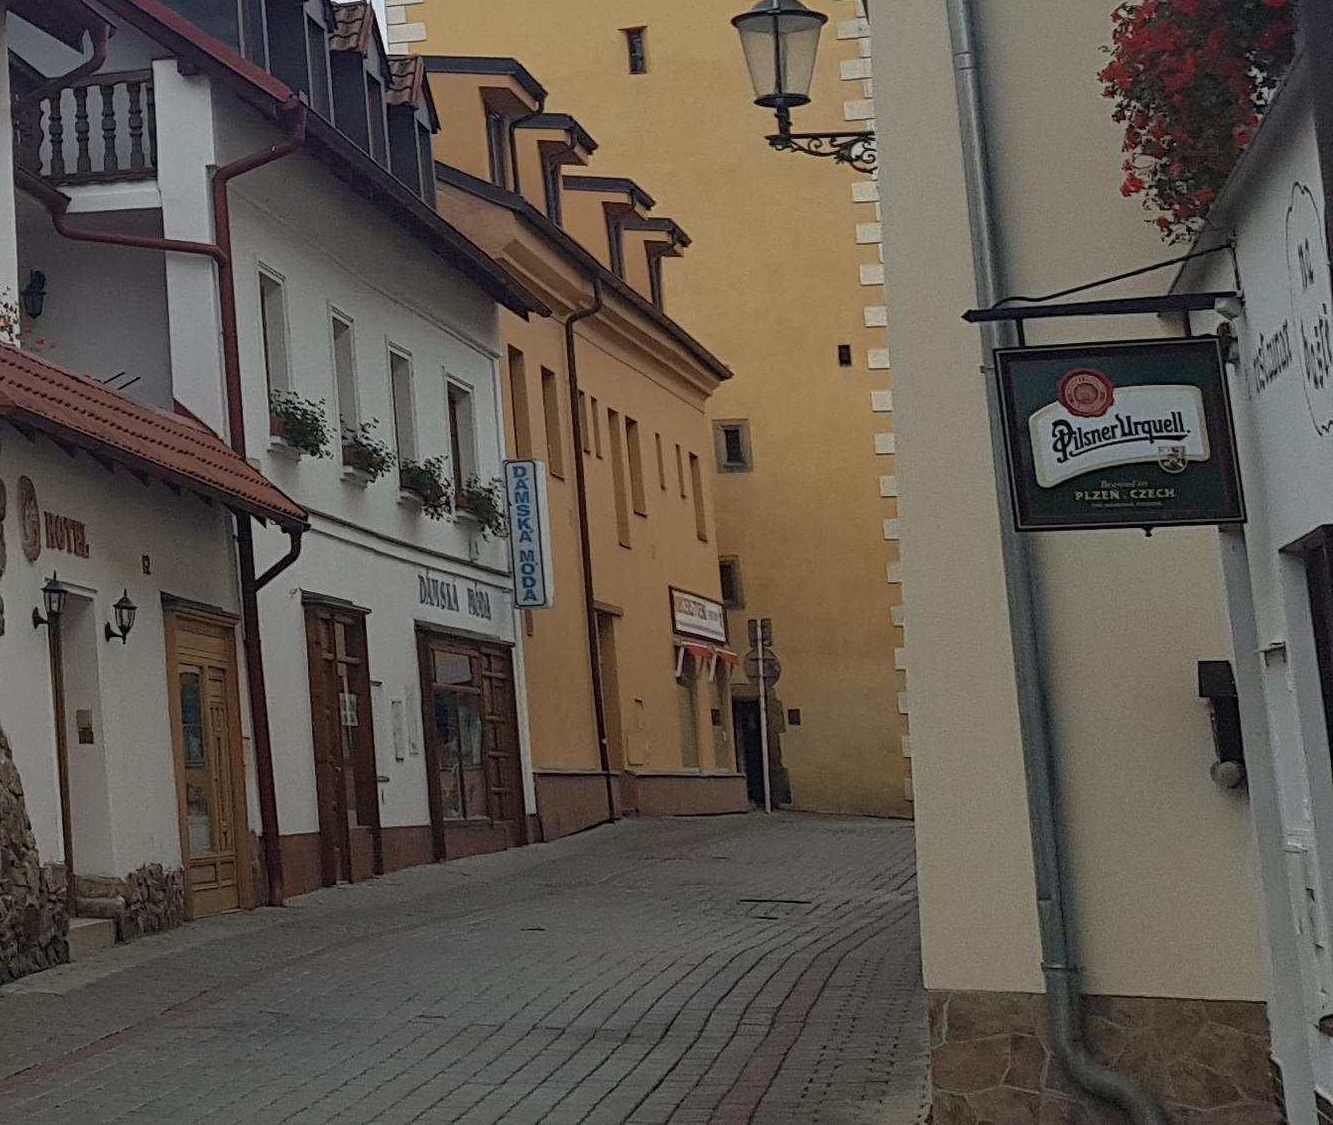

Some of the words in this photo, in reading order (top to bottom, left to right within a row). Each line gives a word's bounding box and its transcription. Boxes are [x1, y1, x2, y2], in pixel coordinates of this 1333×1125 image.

[1052, 419, 1119, 463] Pilsner
[512, 466, 533, 543] DÁMSKÁ
[1129, 488, 1175, 499] CZECH
[44, 510, 90, 559] HOTEL
[519, 550, 539, 602] MÓDA
